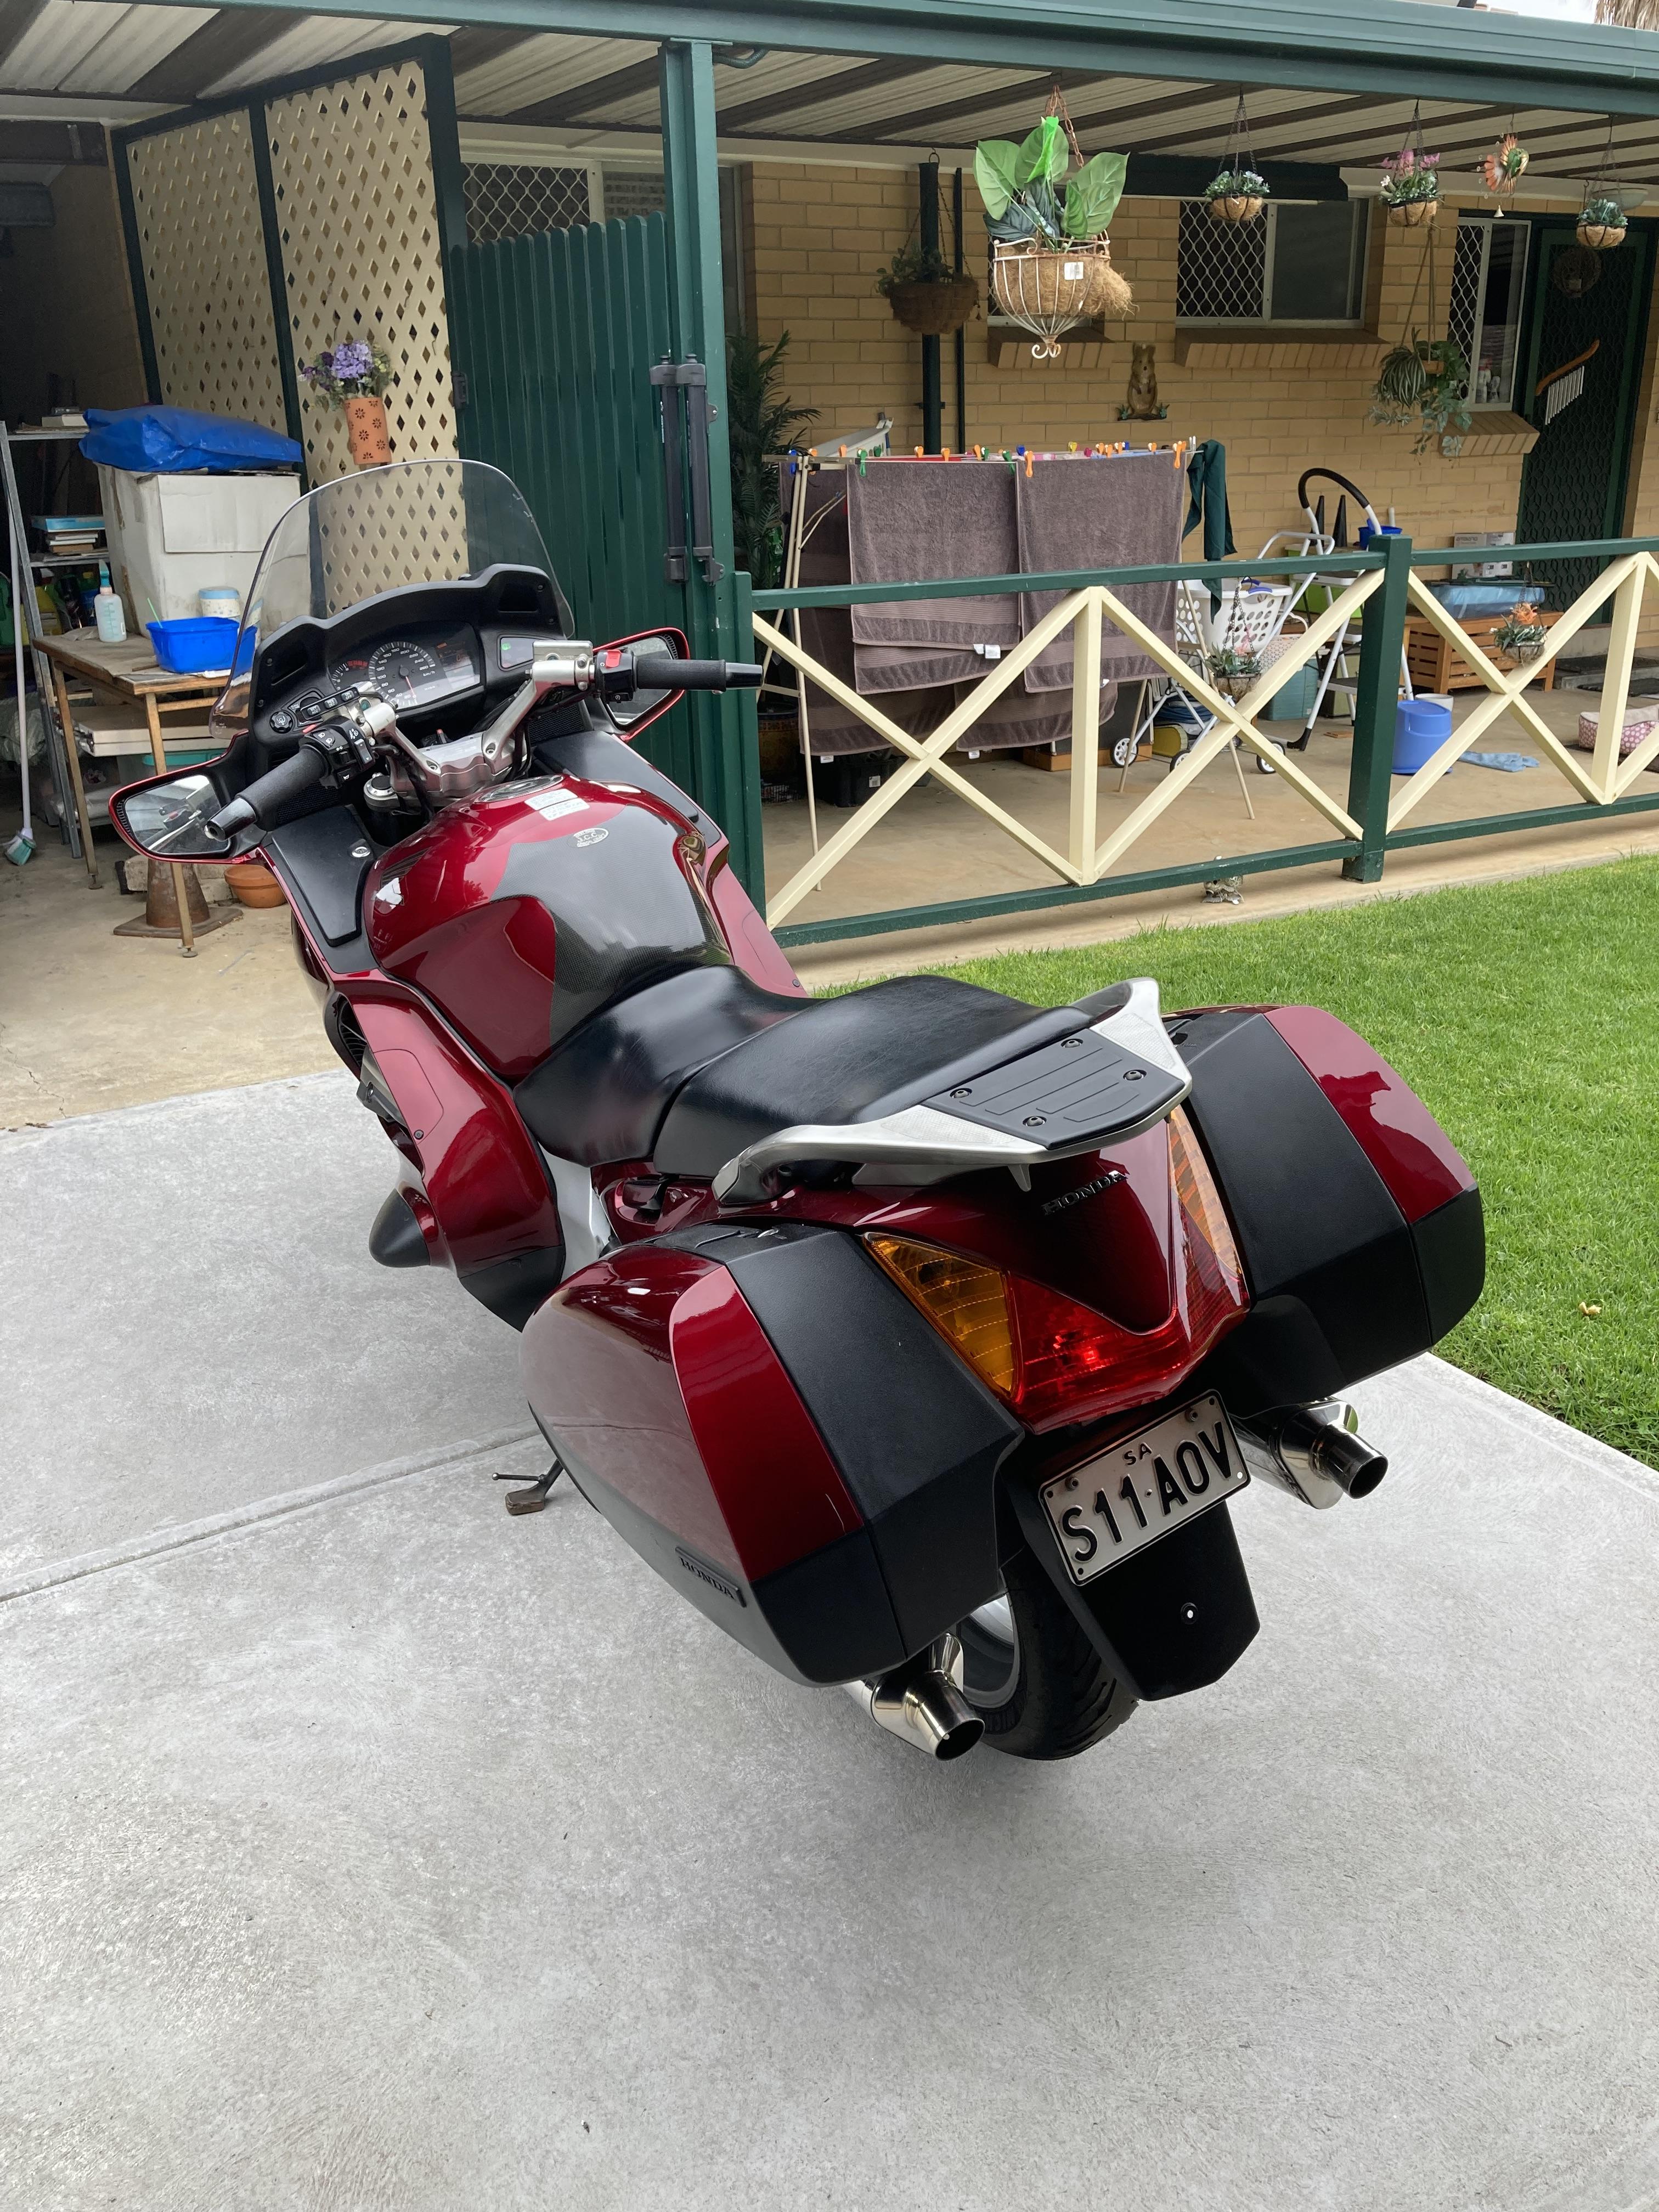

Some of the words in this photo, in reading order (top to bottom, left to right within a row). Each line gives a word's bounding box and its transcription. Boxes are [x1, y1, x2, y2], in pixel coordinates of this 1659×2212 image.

[1041, 1167, 1128, 1216] HONDA
[1123, 1442, 1152, 1466] SA
[678, 1556, 736, 1601] HONDA
